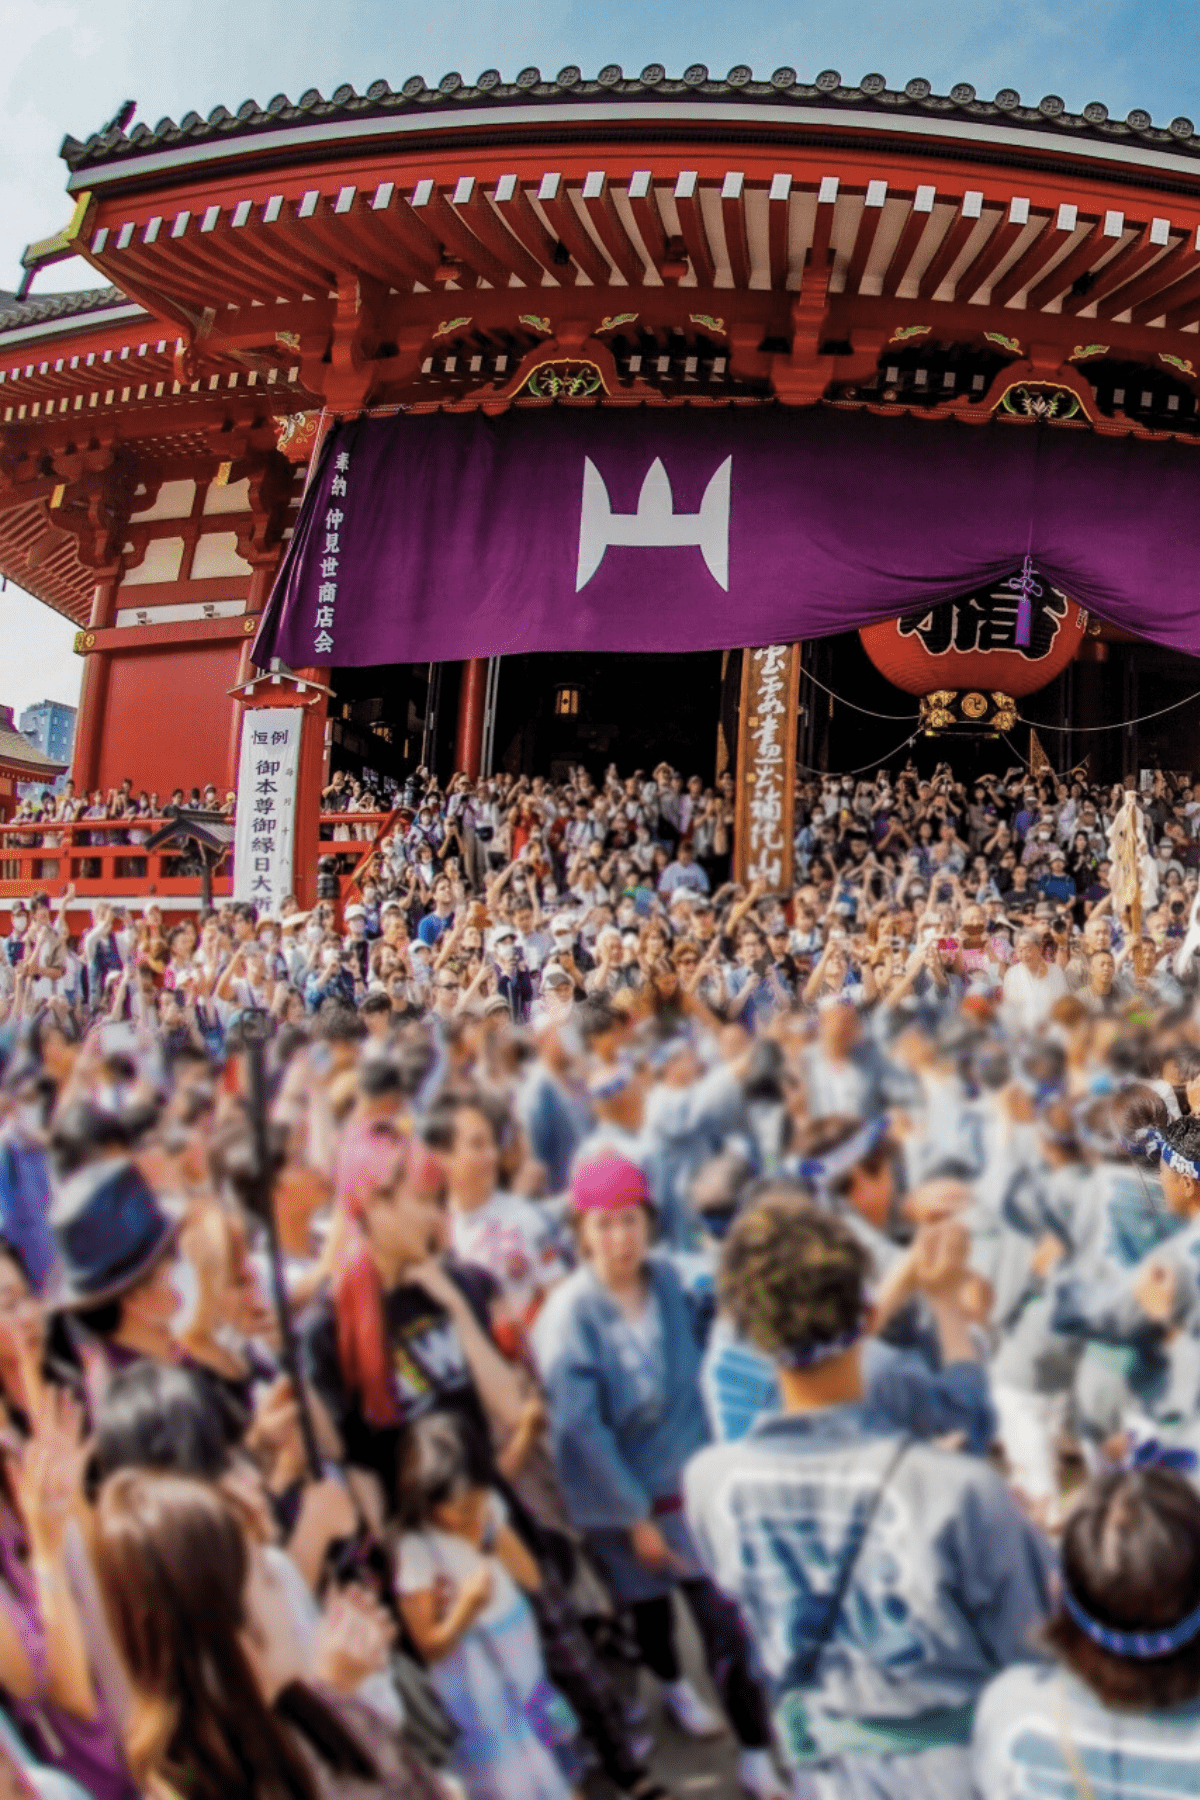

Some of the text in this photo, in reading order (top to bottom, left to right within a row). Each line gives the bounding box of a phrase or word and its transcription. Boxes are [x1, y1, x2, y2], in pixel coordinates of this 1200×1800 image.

[331, 452, 350, 497] 奉納
[314, 508, 344, 654] 仲見世商店会
[251, 729, 289, 746] 恒例
